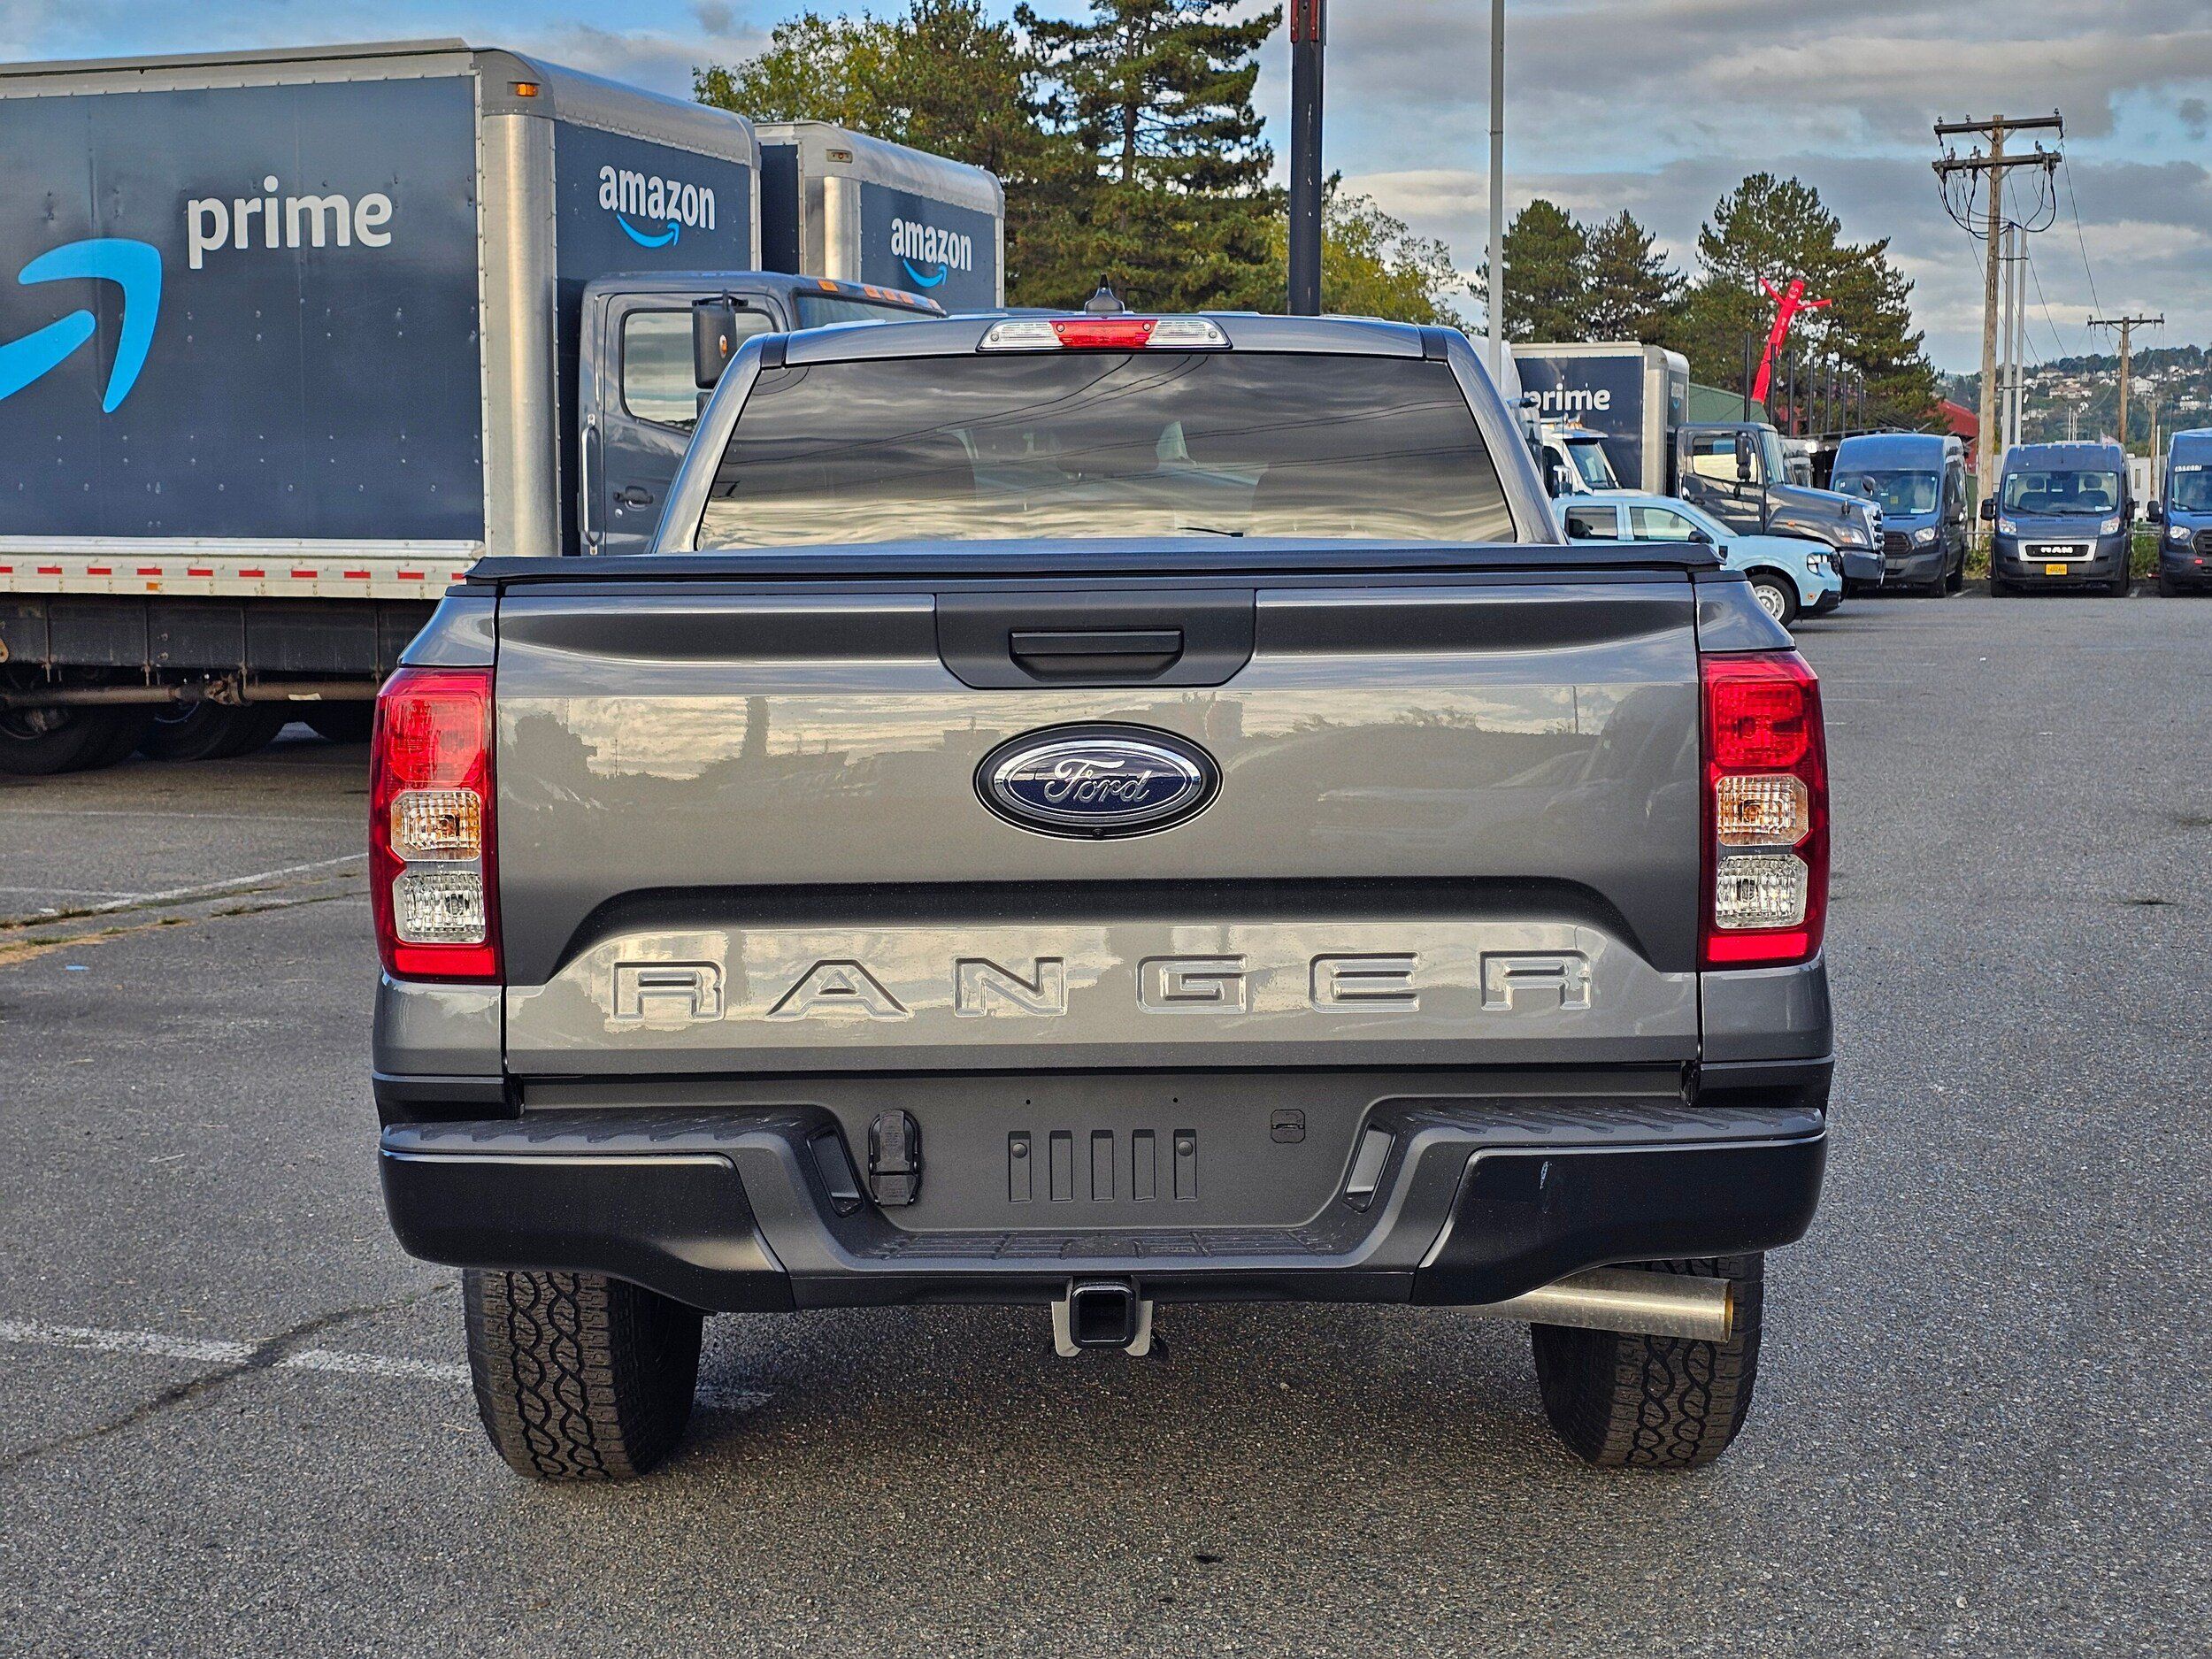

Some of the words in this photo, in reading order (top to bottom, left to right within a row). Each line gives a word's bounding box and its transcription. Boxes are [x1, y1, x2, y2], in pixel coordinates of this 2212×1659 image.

[188, 175, 393, 269] prime
[598, 165, 715, 231] amazon
[890, 217, 972, 272] amazon
[1044, 758, 1152, 803] Ford
[613, 949, 1591, 1020] RANGER
